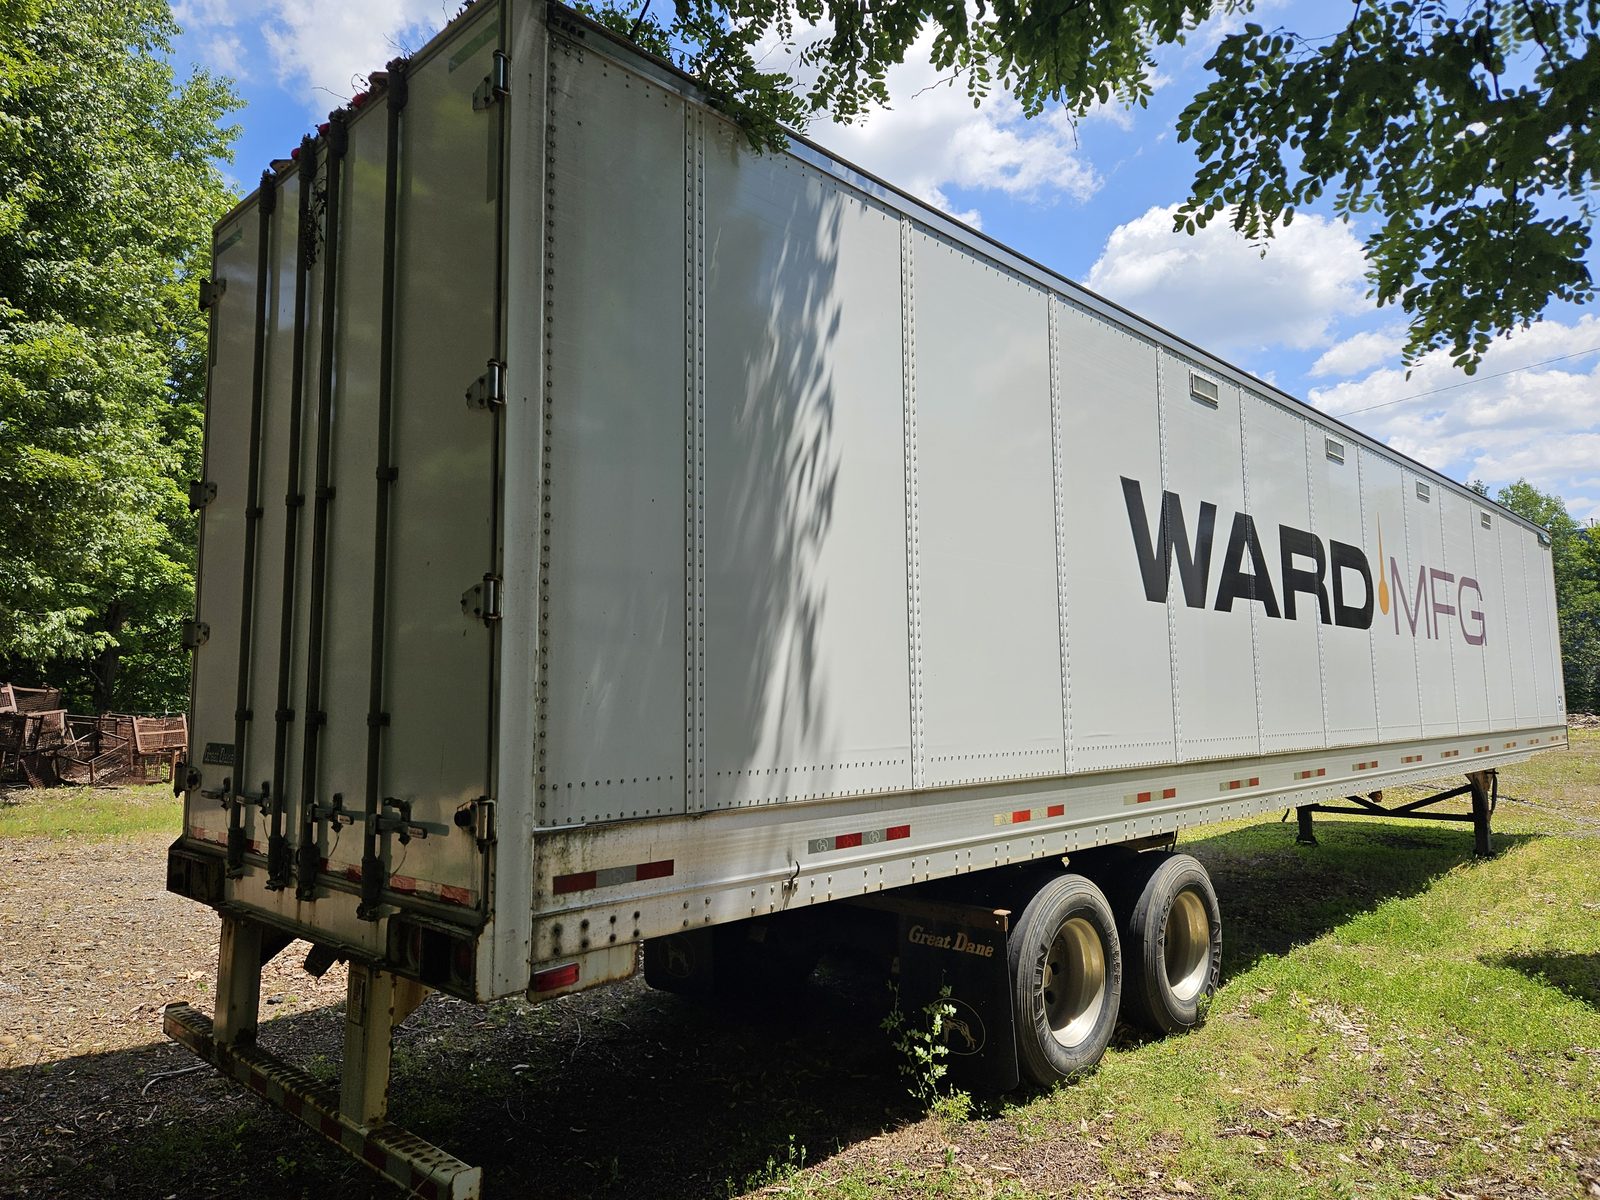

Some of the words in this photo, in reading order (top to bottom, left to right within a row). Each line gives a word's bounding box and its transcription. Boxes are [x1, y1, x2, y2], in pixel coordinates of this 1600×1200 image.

[1120, 475, 1374, 630] WARD
[1389, 556, 1488, 646] MFG
[908, 924, 952, 950] Great
[952, 932, 994, 958] Dane
